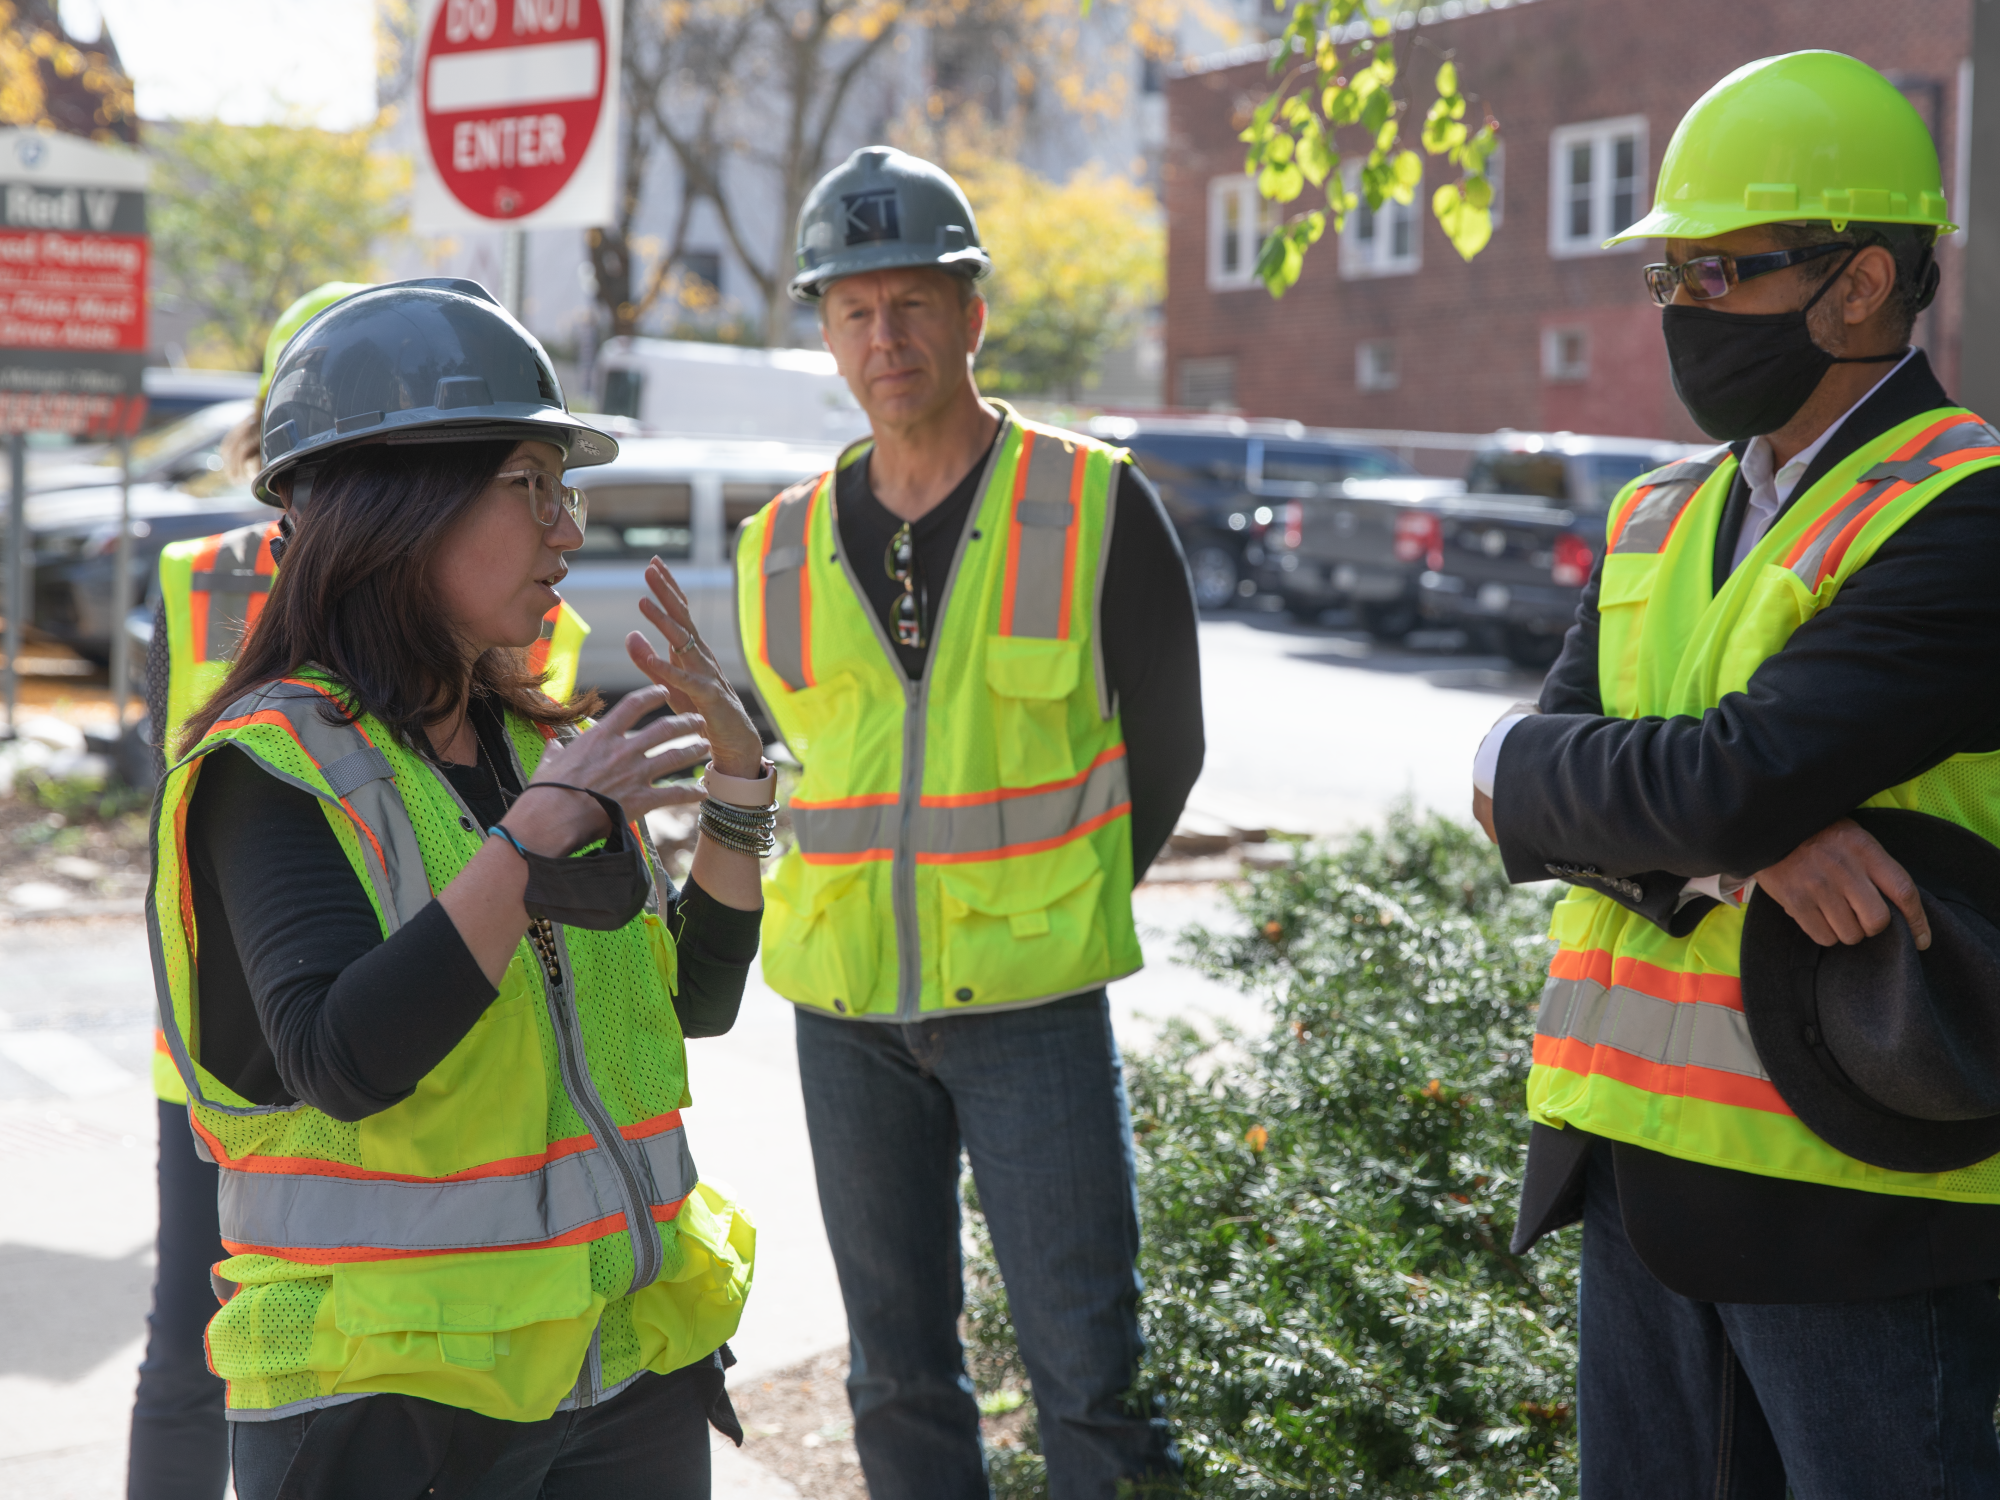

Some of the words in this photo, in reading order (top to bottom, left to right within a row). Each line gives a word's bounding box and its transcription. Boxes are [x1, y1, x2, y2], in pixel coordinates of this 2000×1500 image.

[445, 0, 498, 43] DO
[512, 0, 580, 36] NOT
[452, 113, 566, 172] ENTER
